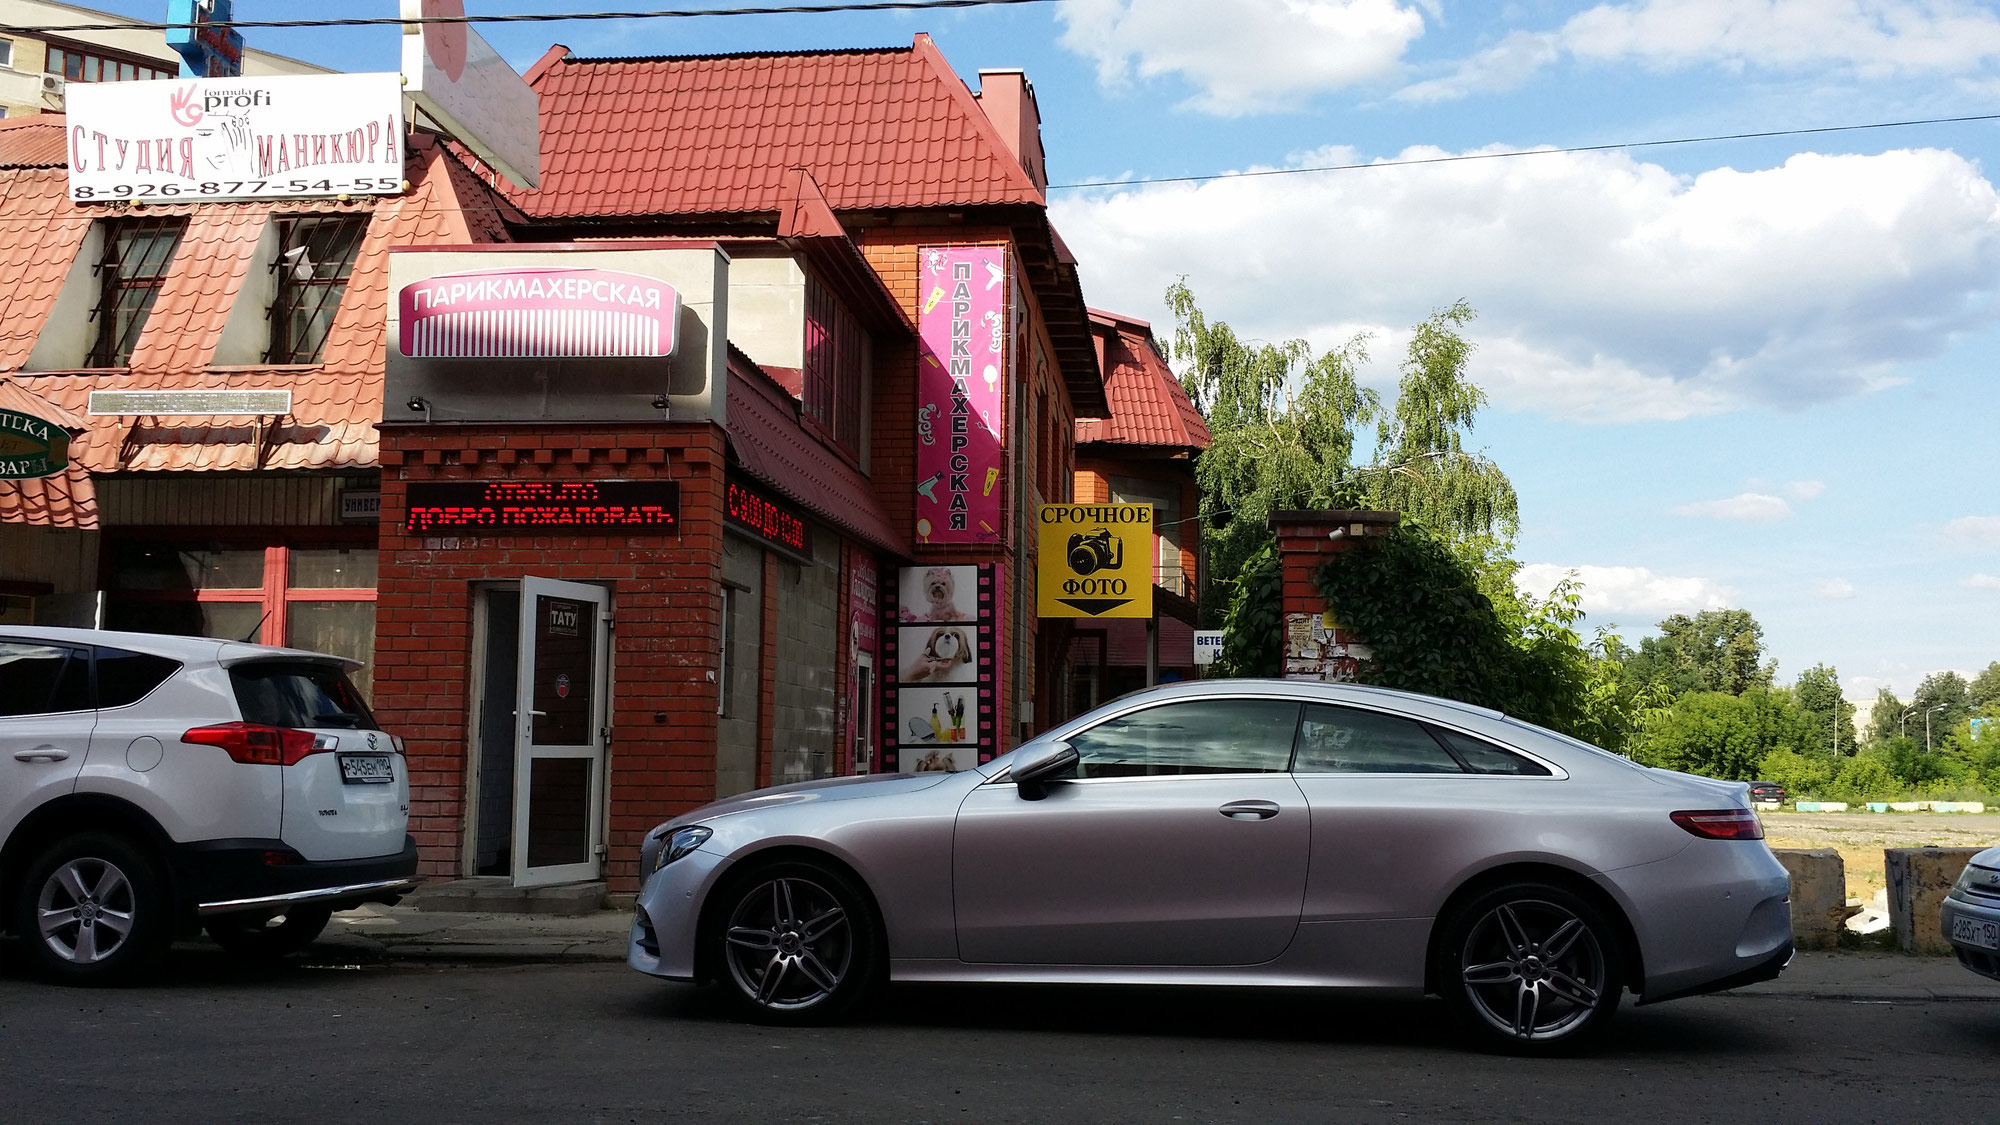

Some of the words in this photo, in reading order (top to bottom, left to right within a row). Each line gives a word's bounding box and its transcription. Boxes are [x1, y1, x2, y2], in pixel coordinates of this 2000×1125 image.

[204, 88, 252, 97] formula
[204, 89, 271, 112] profi
[72, 124, 196, 181] СТУДИЯ
[256, 113, 399, 179] МАНИКЮРА
[74, 177, 399, 199] 8-926-877-54-55
[413, 277, 661, 312] ПАРИКМАХЕРСКАЯ
[949, 262, 972, 531] ПАРИКМАХЕРСКАЯ
[1040, 506, 1151, 524] СРОЧНОЕ
[1062, 578, 1127, 596] ФОТО
[551, 610, 577, 627] ТАТУ
